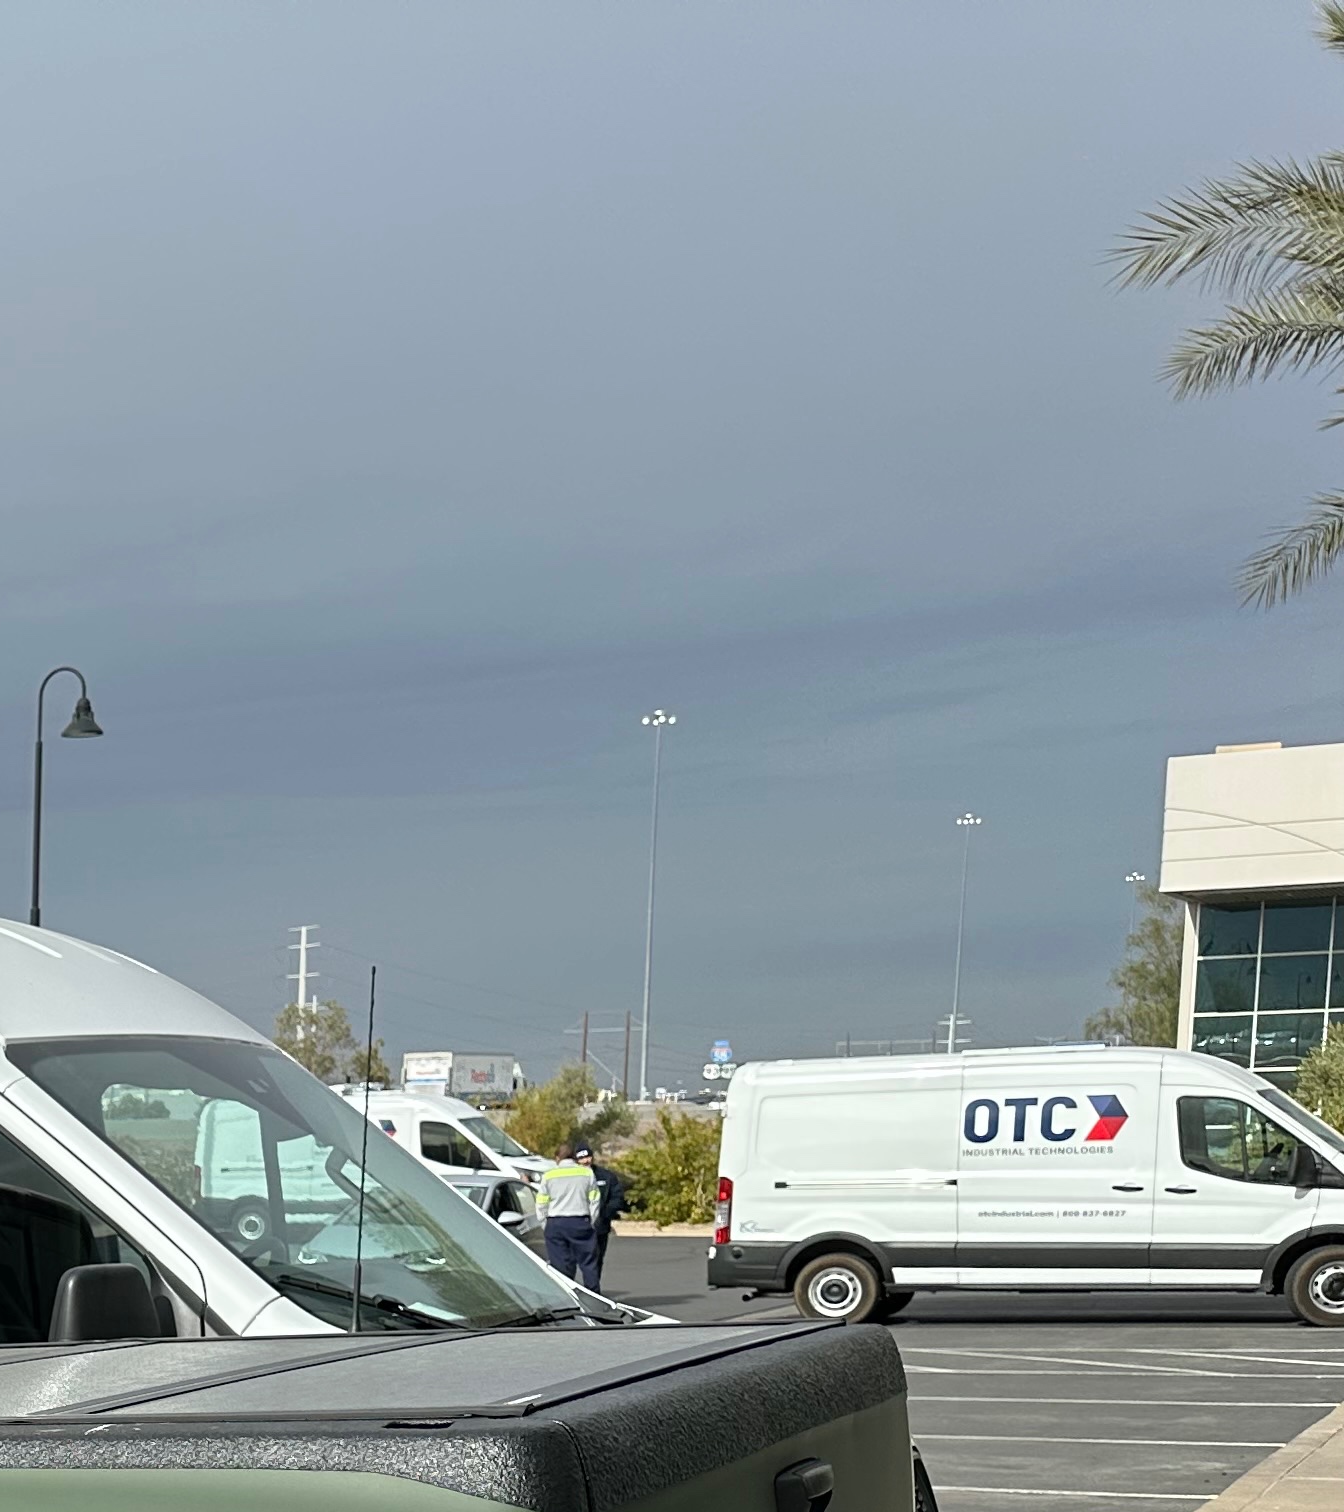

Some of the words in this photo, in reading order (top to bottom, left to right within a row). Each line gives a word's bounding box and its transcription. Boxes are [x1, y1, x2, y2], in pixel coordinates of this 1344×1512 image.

[963, 1096, 1078, 1143] OTC
[962, 1147, 1025, 1157] INDUSTRIAL
[1029, 1145, 1114, 1156] TECHNOLOGIES
